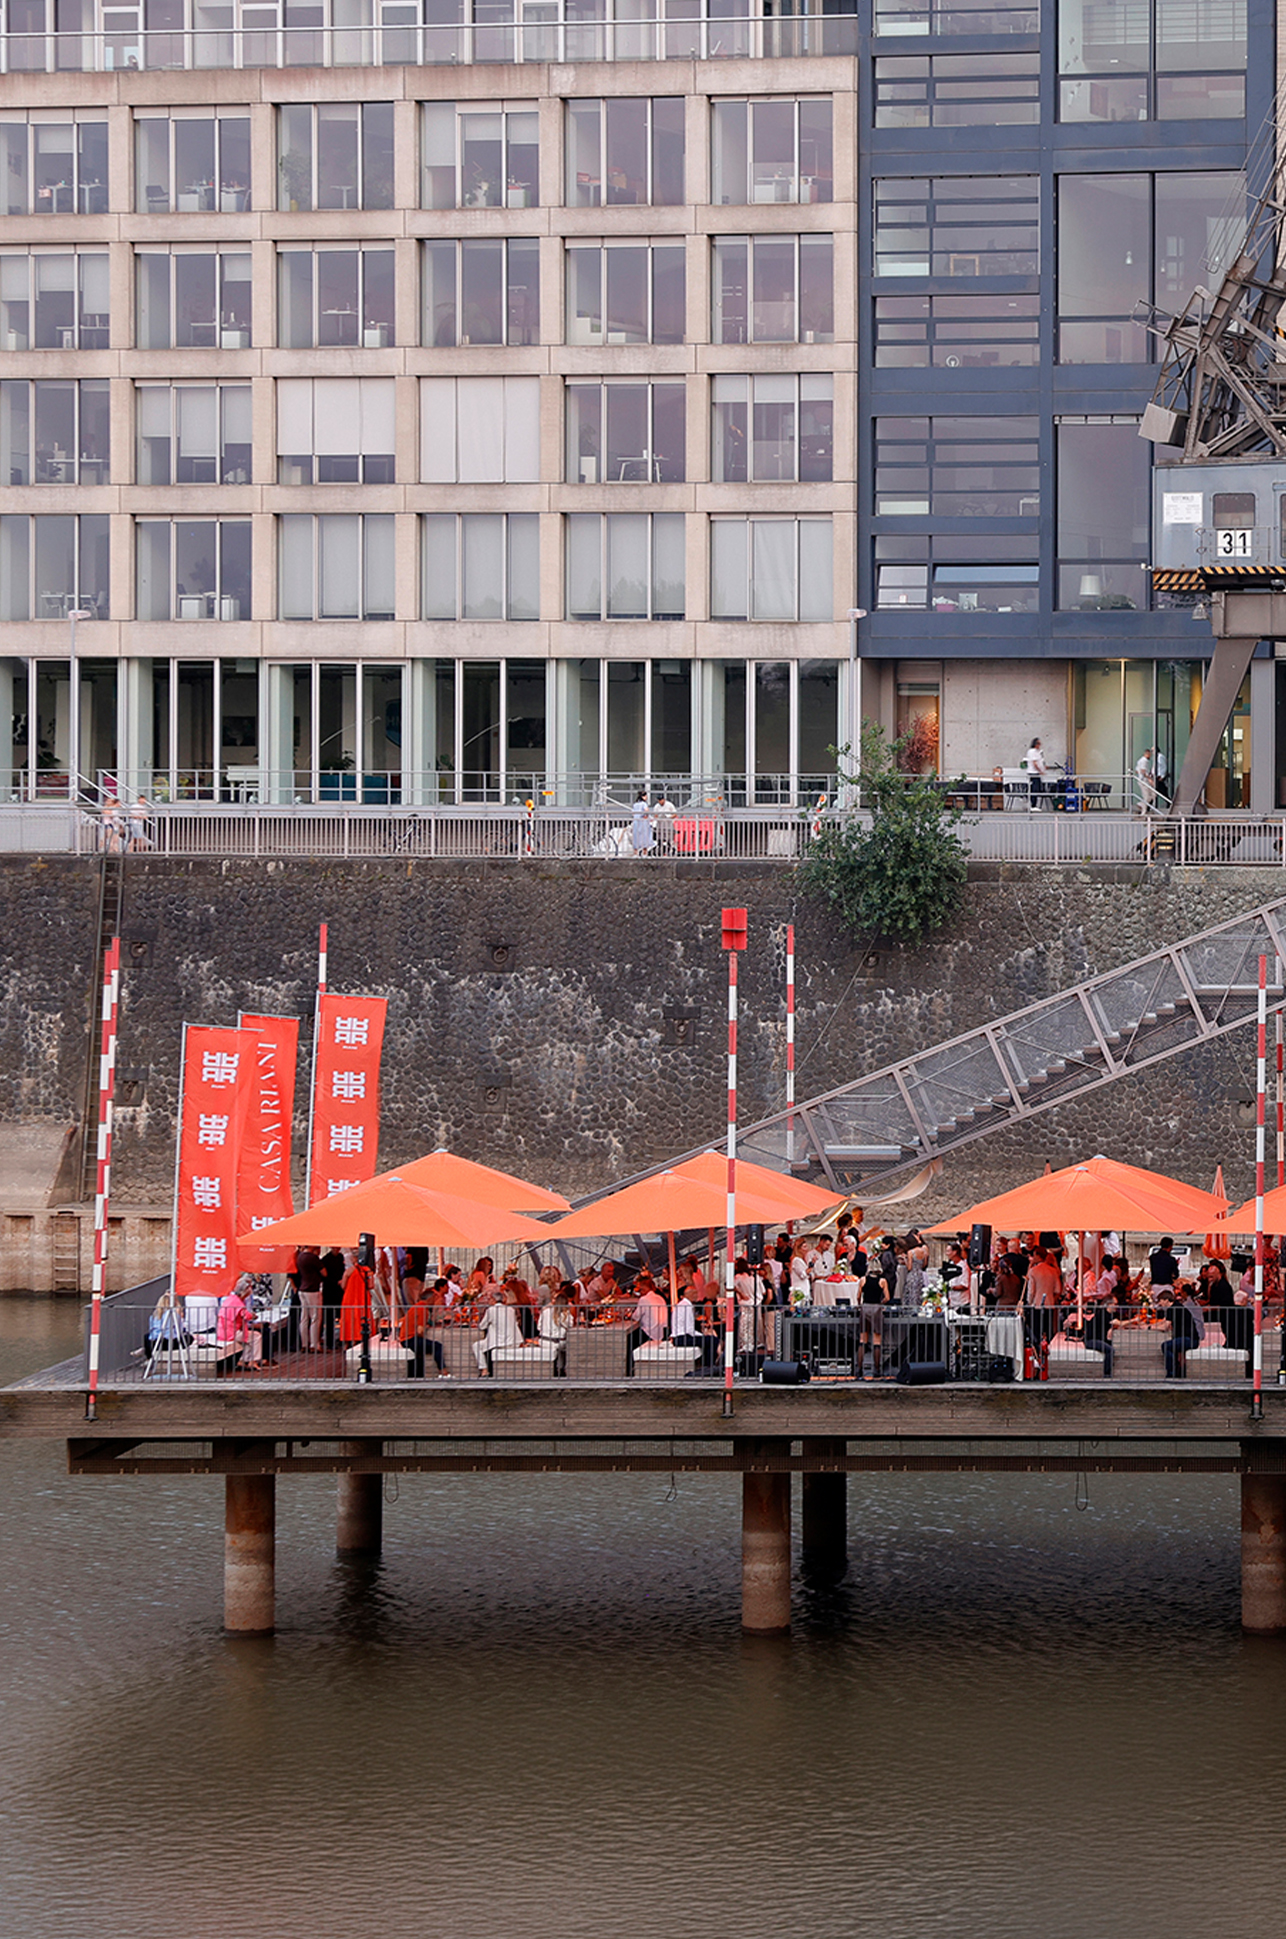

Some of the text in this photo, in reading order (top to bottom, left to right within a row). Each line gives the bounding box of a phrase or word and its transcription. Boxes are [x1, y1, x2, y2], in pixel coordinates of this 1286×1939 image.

[1222, 532, 1247, 555] 31
[257, 1042, 282, 1194] CASA RIANI
